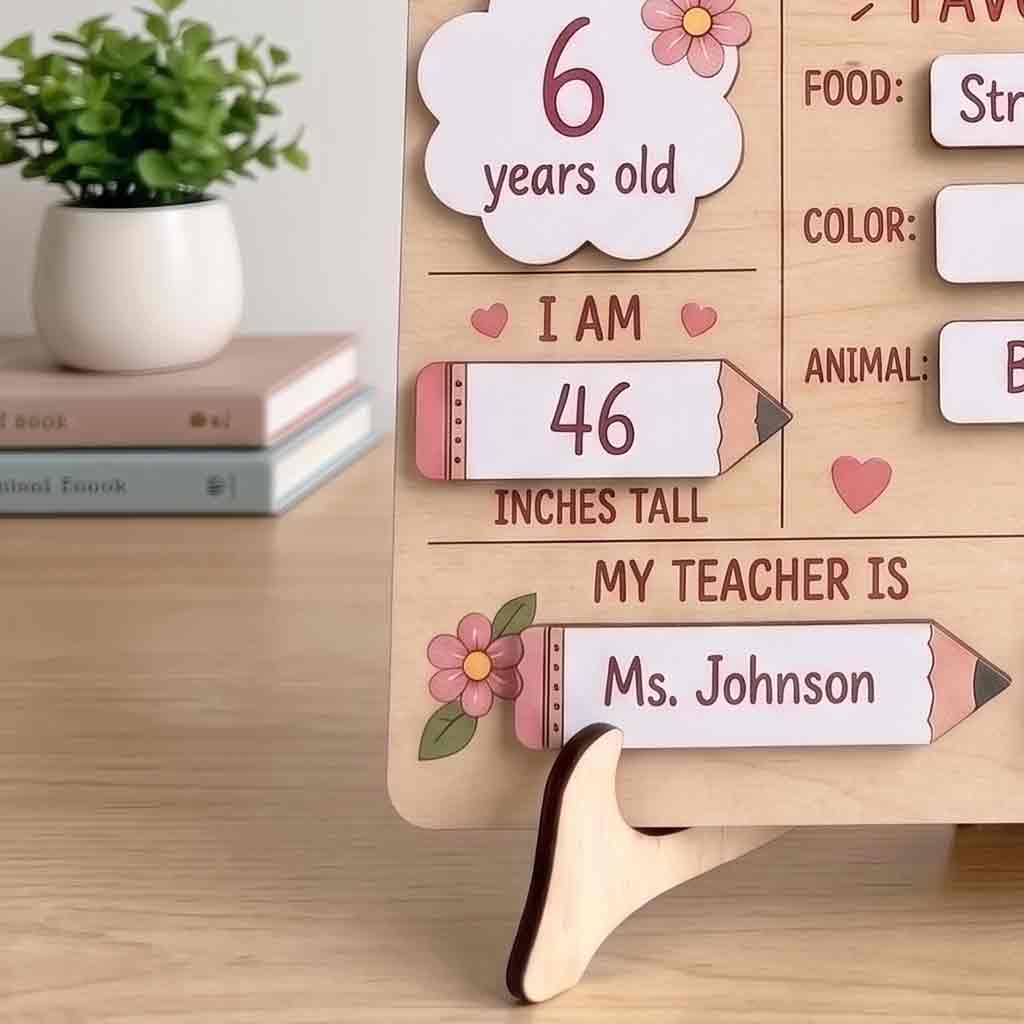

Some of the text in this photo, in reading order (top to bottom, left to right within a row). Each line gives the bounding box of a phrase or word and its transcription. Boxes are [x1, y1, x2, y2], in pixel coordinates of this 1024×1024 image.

[541, 15, 606, 139] 6
[804, 68, 904, 107] FOOD:
[482, 143, 677, 214] years old
[804, 207, 917, 245] COLOR:
[538, 293, 642, 343] I AM
[804, 346, 930, 384] ANIMAL:
[549, 381, 636, 457] 46
[493, 486, 708, 525] INCHES TALL
[593, 556, 910, 604] MY TEACHER IS
[603, 653, 875, 708] Ms. Johnson
